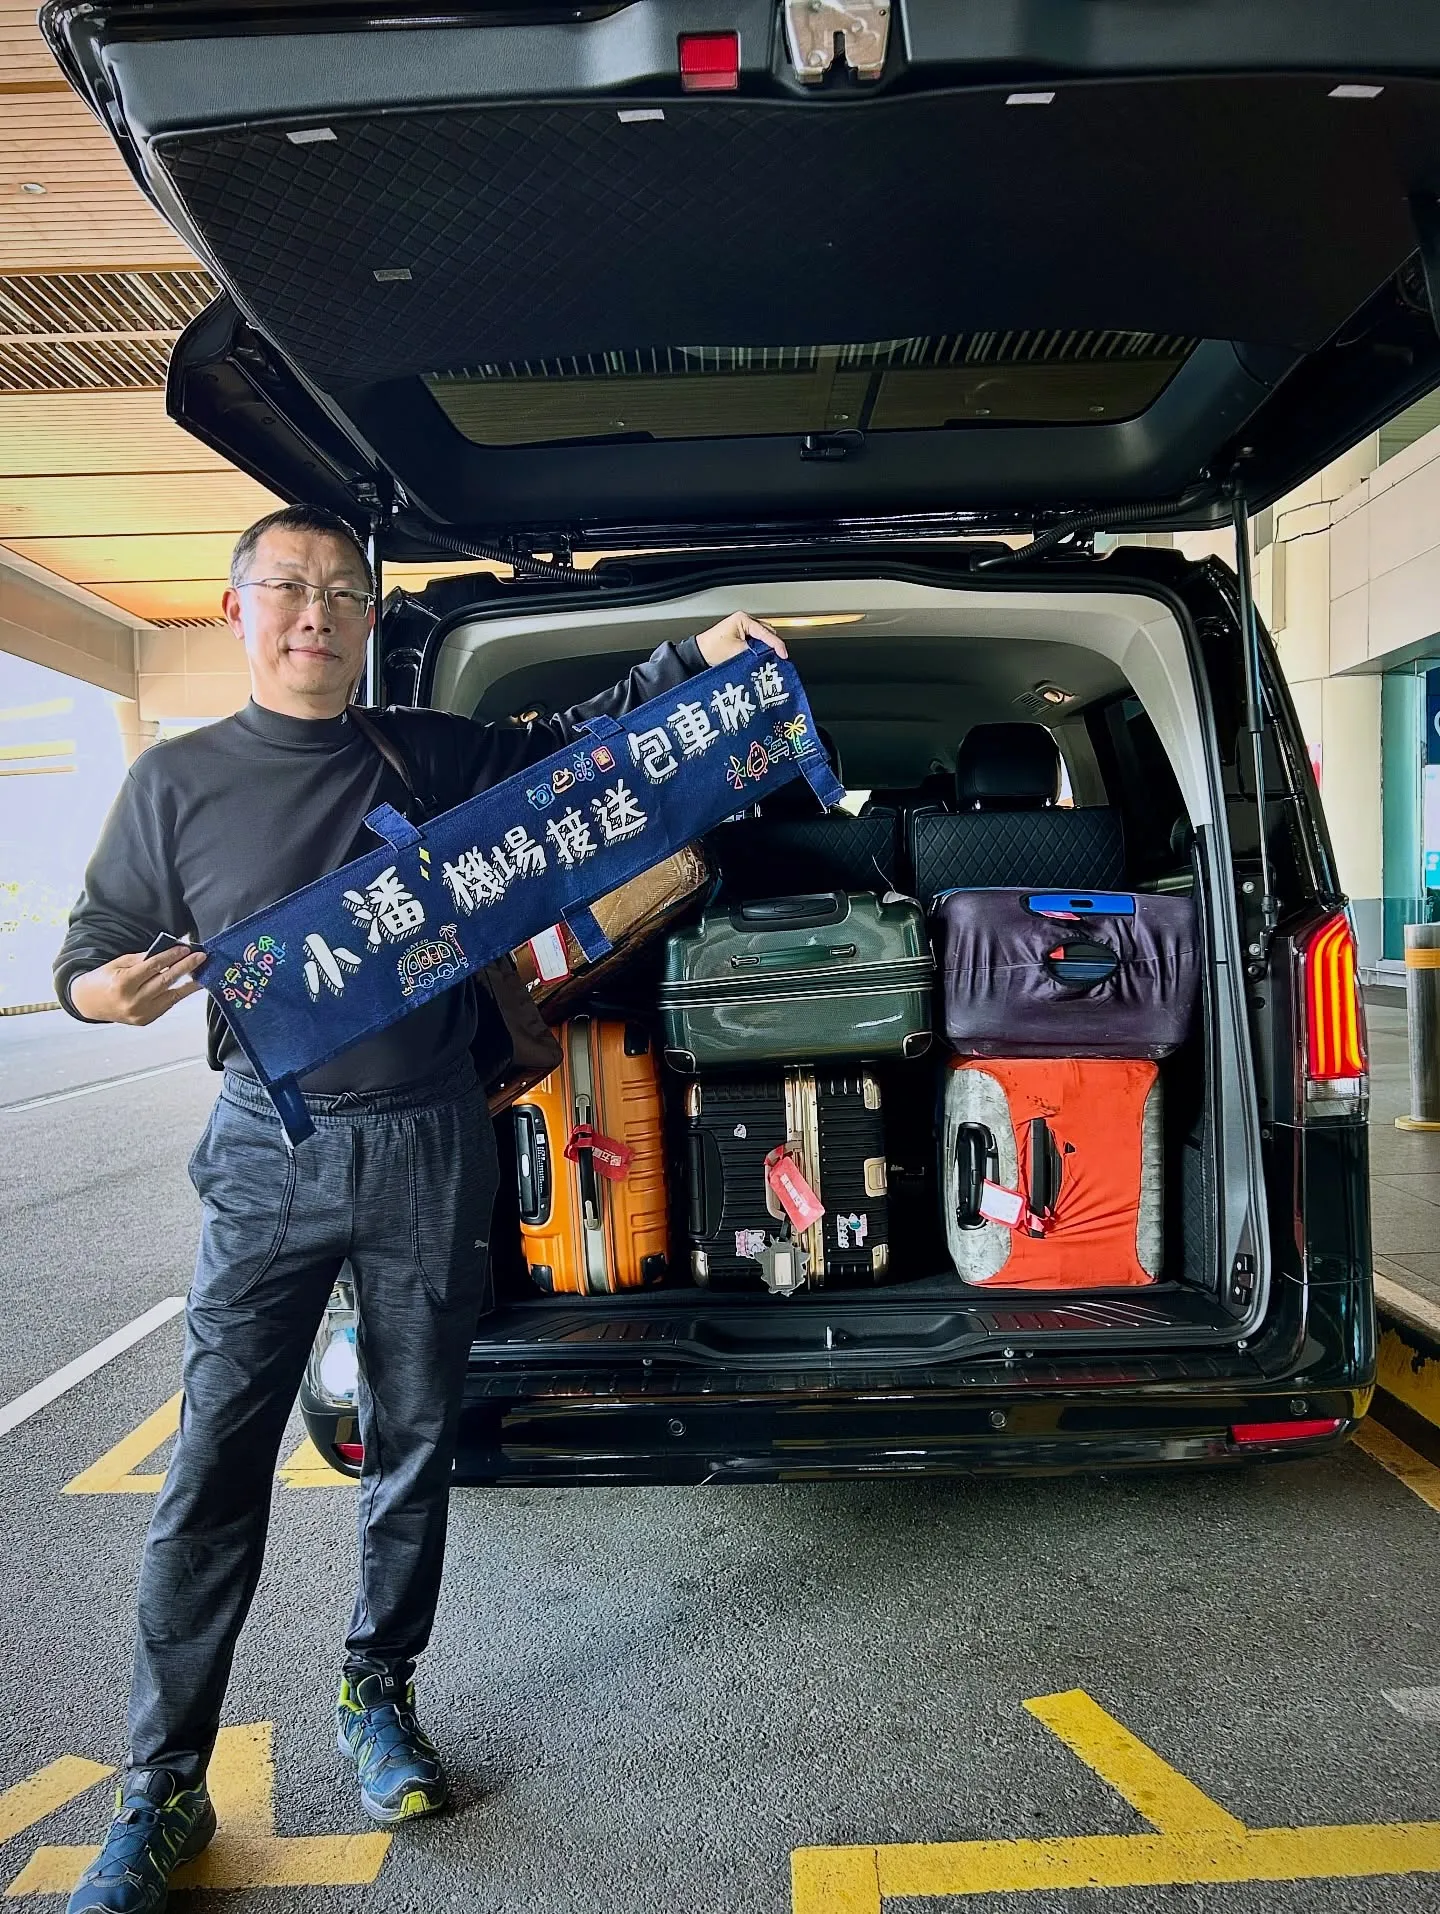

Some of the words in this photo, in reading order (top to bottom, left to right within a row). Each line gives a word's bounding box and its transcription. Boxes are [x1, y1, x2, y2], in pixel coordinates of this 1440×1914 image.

[303, 865, 426, 995] 小潘
[442, 778, 649, 912] 機場接送
[627, 661, 790, 783] 包車旅遊
[257, 953, 274, 977] go
